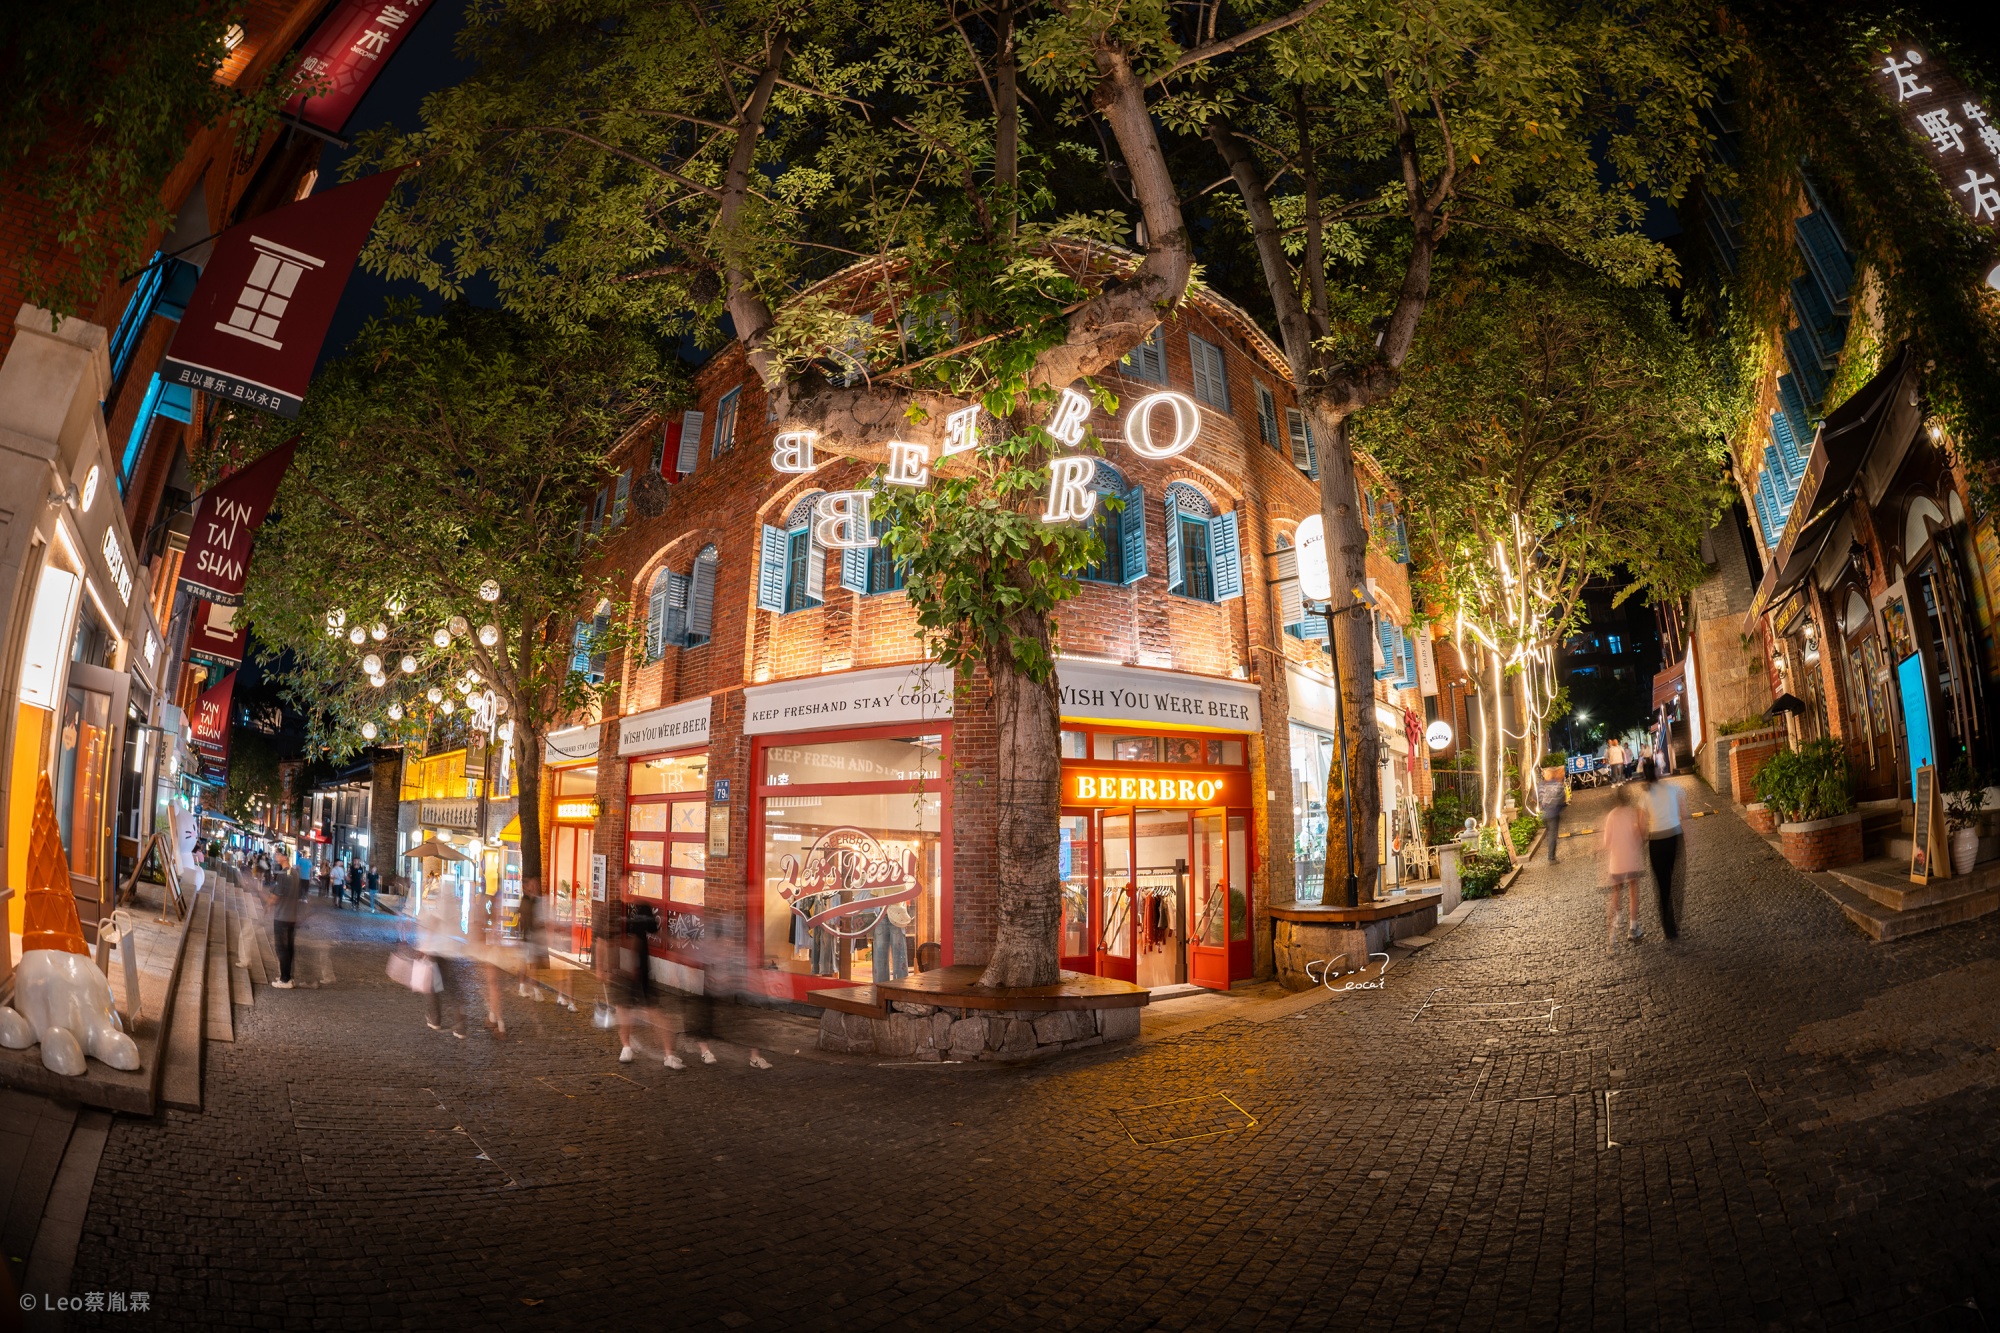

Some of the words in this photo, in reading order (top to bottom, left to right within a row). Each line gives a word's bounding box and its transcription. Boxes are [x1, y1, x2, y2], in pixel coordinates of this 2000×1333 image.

[215, 496, 252, 526] YAN
[752, 709, 780, 722] KEEP
[784, 700, 848, 718] FRESHAND
[853, 694, 894, 710] STAY
[900, 692, 942, 707] COOL
[1109, 688, 1149, 709] YOU
[1154, 693, 1204, 715] WERE
[1208, 701, 1250, 721] BEER
[624, 731, 641, 745] WISH
[641, 727, 657, 742] YOU
[658, 723, 681, 738] WERE
[682, 717, 707, 734] BEER
[767, 746, 802, 764] KEEP
[804, 751, 845, 771] FRESH
[848, 758, 873, 773] AND
